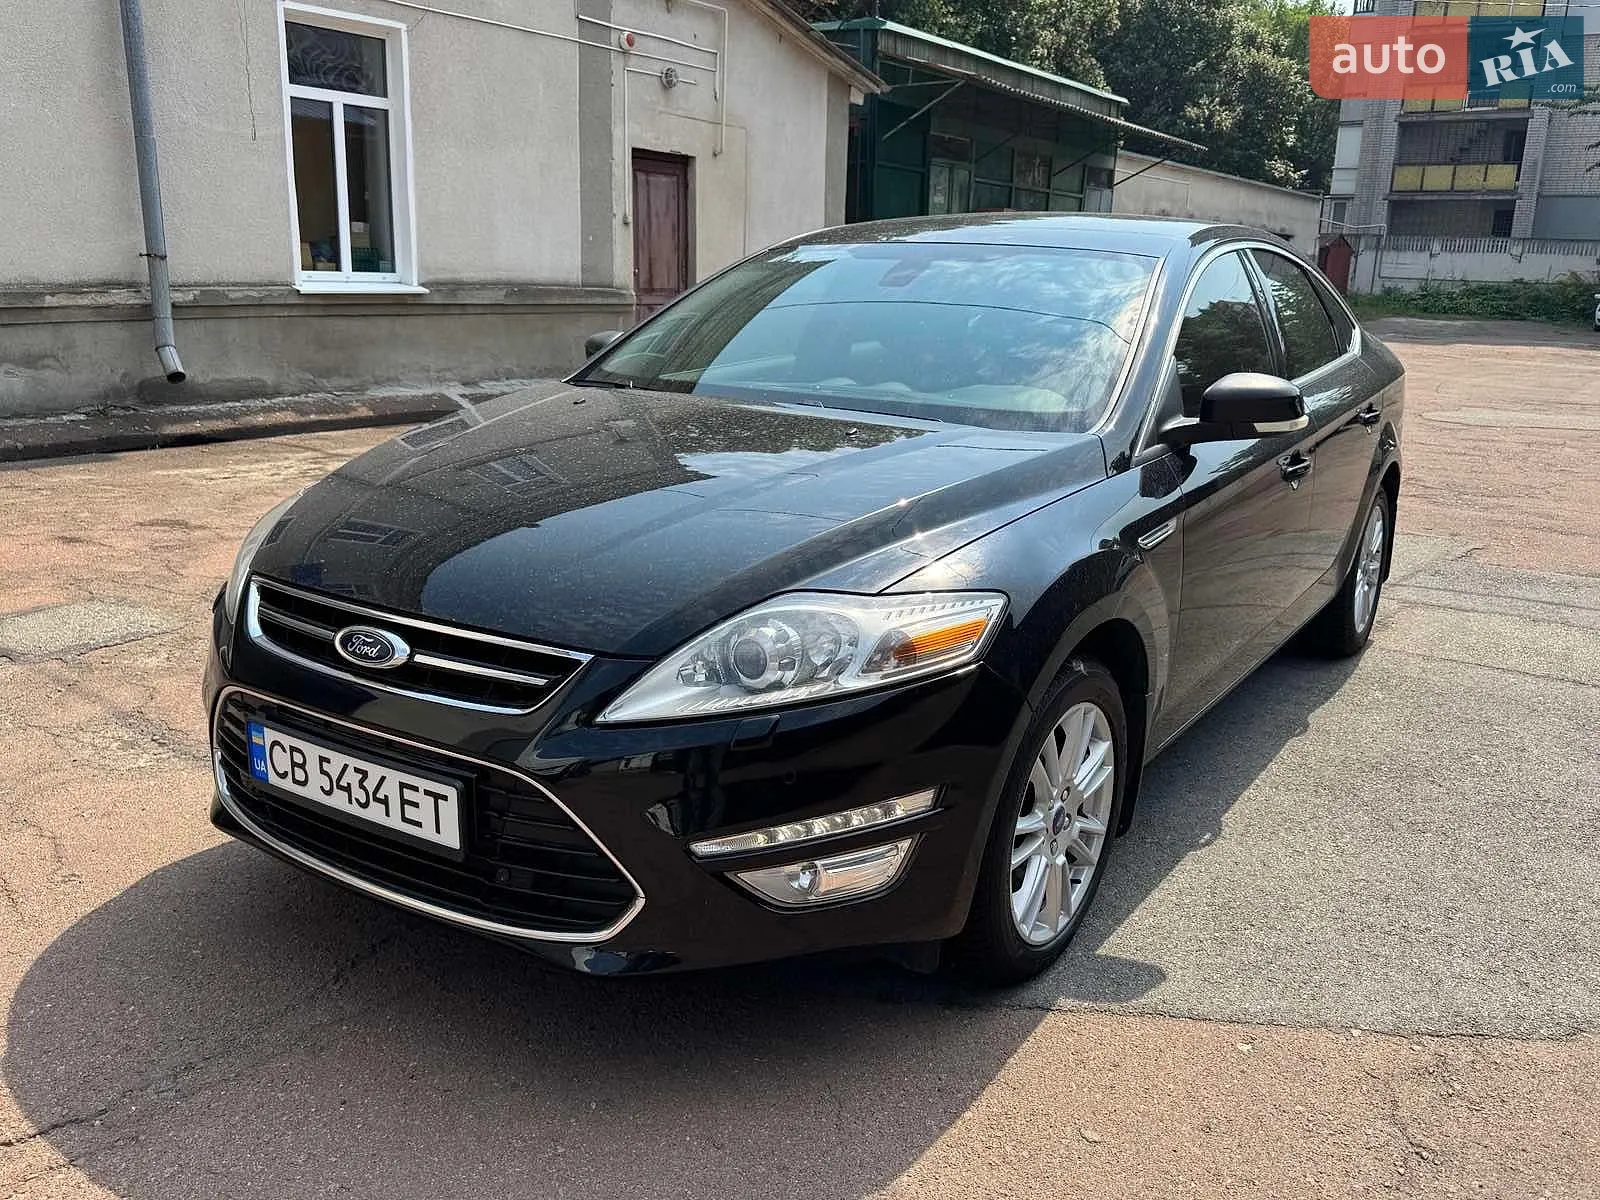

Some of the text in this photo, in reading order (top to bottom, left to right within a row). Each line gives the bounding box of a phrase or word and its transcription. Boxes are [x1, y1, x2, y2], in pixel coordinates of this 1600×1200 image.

[347, 634, 381, 658] Ford
[254, 757, 267, 774] UA
[269, 740, 449, 835] CB 5434 ET
